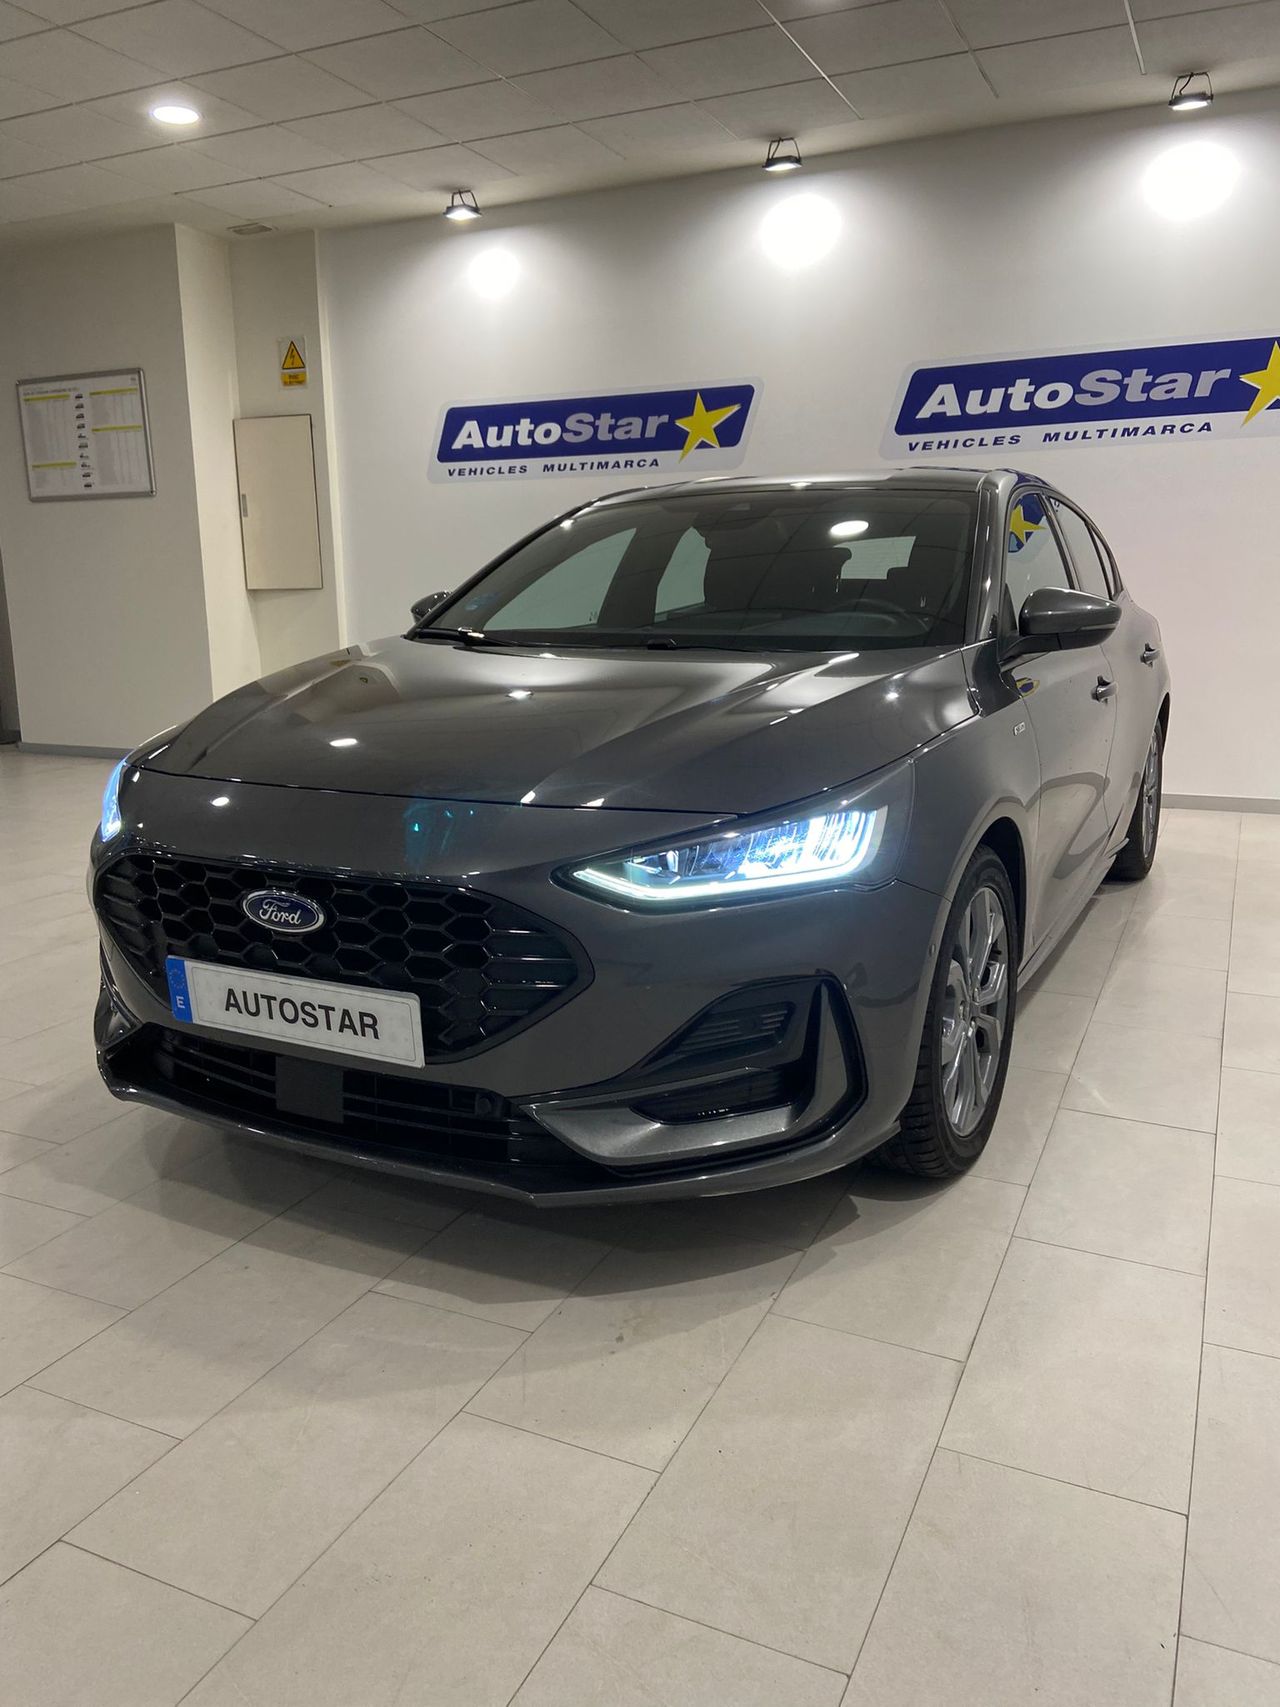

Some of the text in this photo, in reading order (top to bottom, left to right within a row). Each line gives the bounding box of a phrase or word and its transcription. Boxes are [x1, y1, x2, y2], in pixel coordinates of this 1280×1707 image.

[915, 369, 1232, 419] AutoStar
[451, 412, 669, 450] AutoStar
[908, 421, 1212, 452] VEHICLES MULTIMARCA
[447, 458, 660, 477] VEHICLES MULTIMARCA
[259, 898, 302, 925] Ford
[175, 988, 380, 1040] E AUTOSTAR
